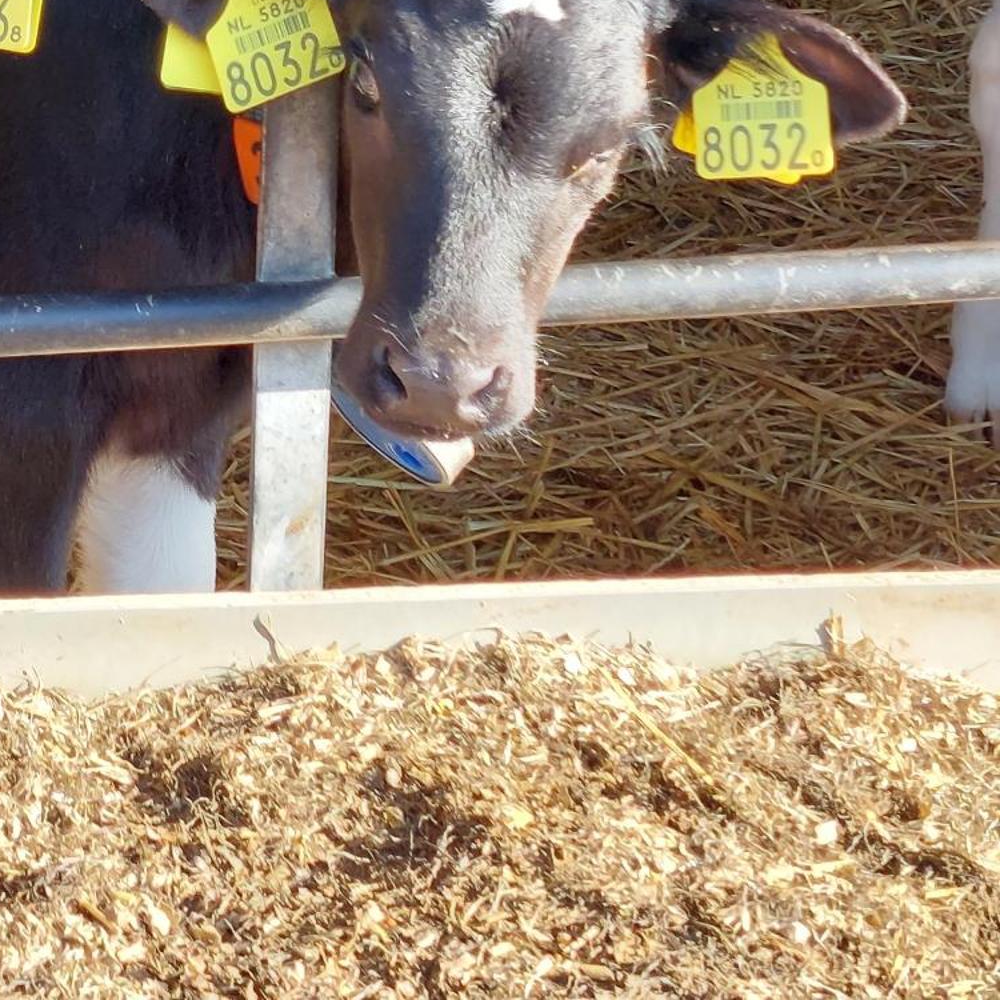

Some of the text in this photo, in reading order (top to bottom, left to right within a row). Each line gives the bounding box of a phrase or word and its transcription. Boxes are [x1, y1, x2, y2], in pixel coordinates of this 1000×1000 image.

[226, 16, 251, 35] NL
[717, 80, 803, 100] NL 5820
